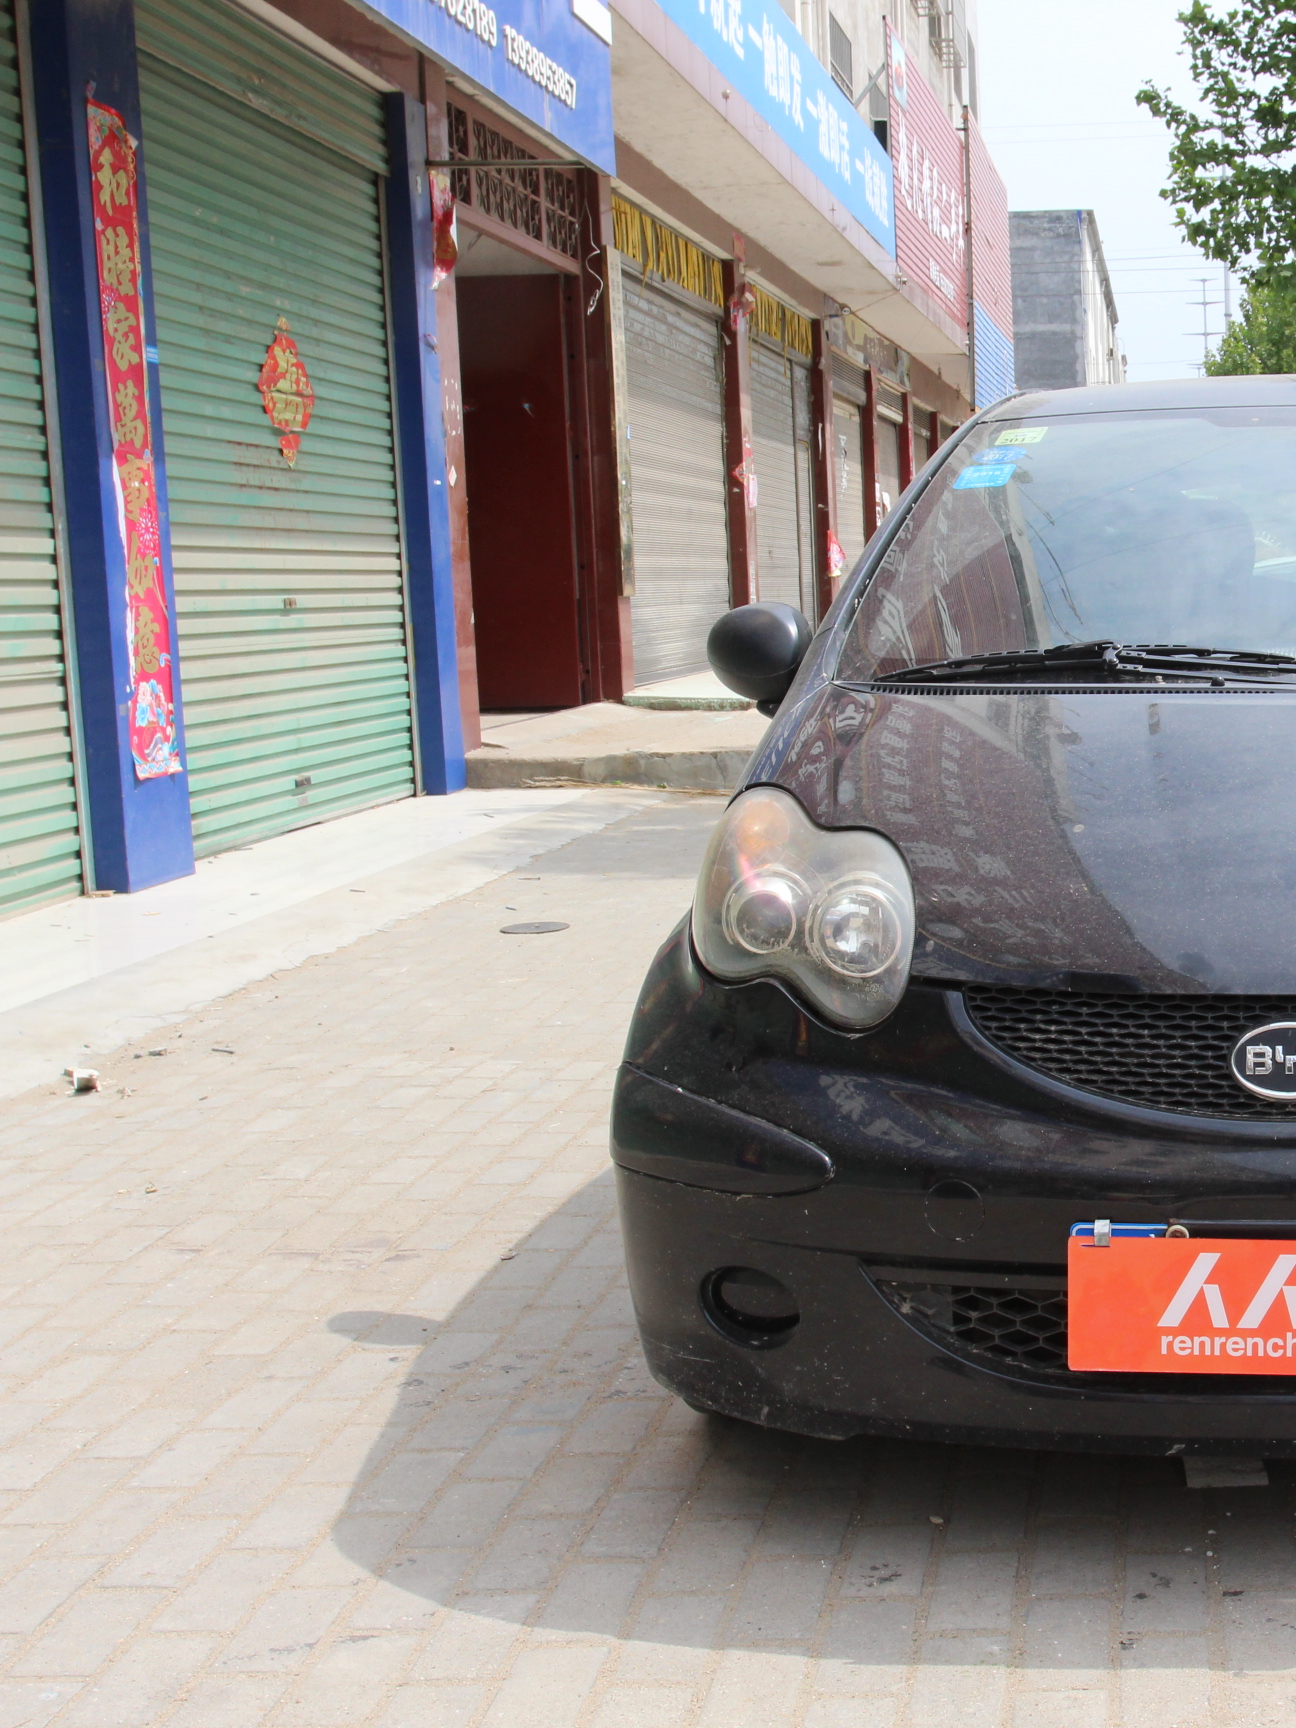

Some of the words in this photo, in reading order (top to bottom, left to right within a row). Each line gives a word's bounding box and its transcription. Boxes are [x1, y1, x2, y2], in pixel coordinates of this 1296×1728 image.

[503, 25, 577, 109] 13938953857
[748, 12, 804, 133] 一触即发
